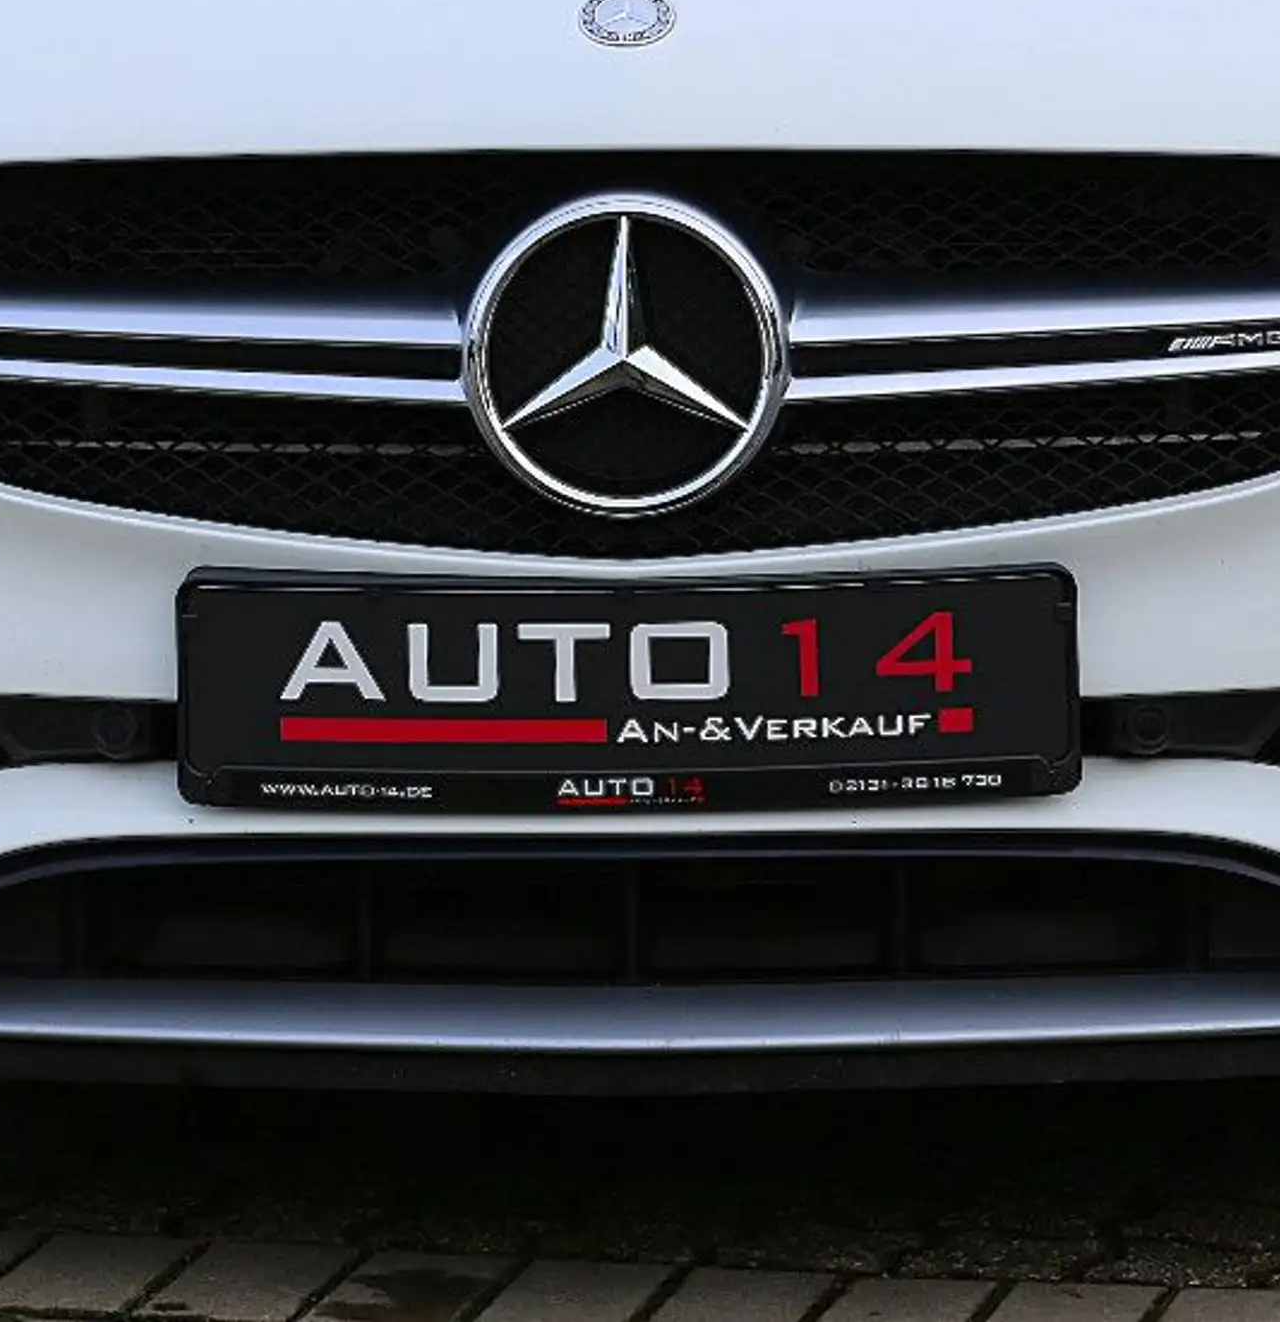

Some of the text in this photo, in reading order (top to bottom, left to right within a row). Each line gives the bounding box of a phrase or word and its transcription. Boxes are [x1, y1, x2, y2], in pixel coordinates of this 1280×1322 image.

[280, 611, 973, 702] AUTO 14
[558, 778, 654, 796] AUTO
